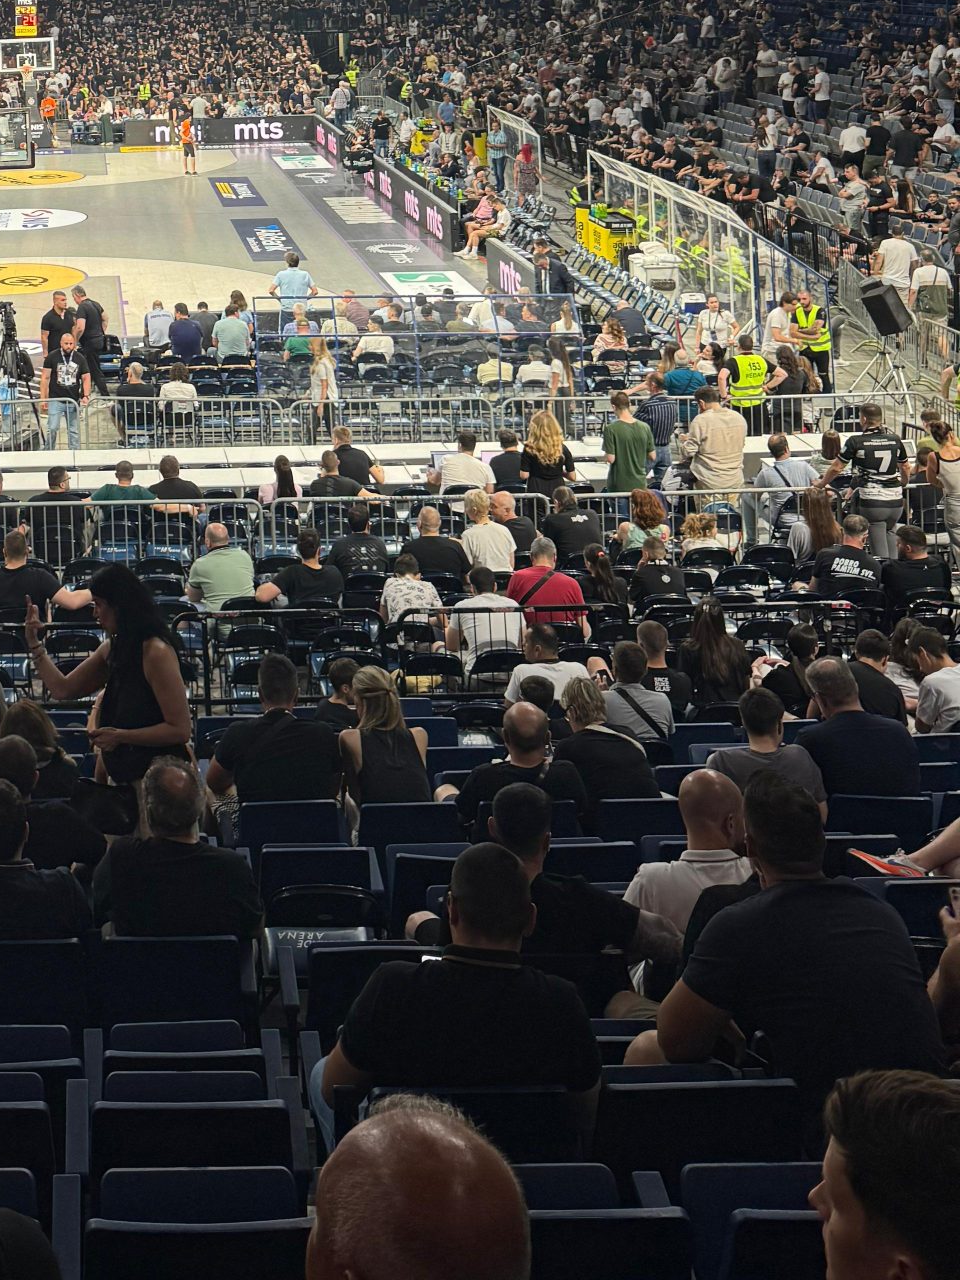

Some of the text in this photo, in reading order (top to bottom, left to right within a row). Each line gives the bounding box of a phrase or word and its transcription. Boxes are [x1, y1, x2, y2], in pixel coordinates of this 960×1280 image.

[22, 15, 37, 26] 24
[234, 118, 285, 141] mts
[379, 170, 393, 200] mts
[404, 190, 420, 222] mts
[426, 205, 444, 241] mts
[499, 260, 522, 295] mts
[747, 361, 762, 371] 153
[874, 450, 892, 473] 7
[831, 563, 861, 576] PAMTIM
[834, 557, 860, 568] DOBRO
[277, 931, 325, 940] ARENA
